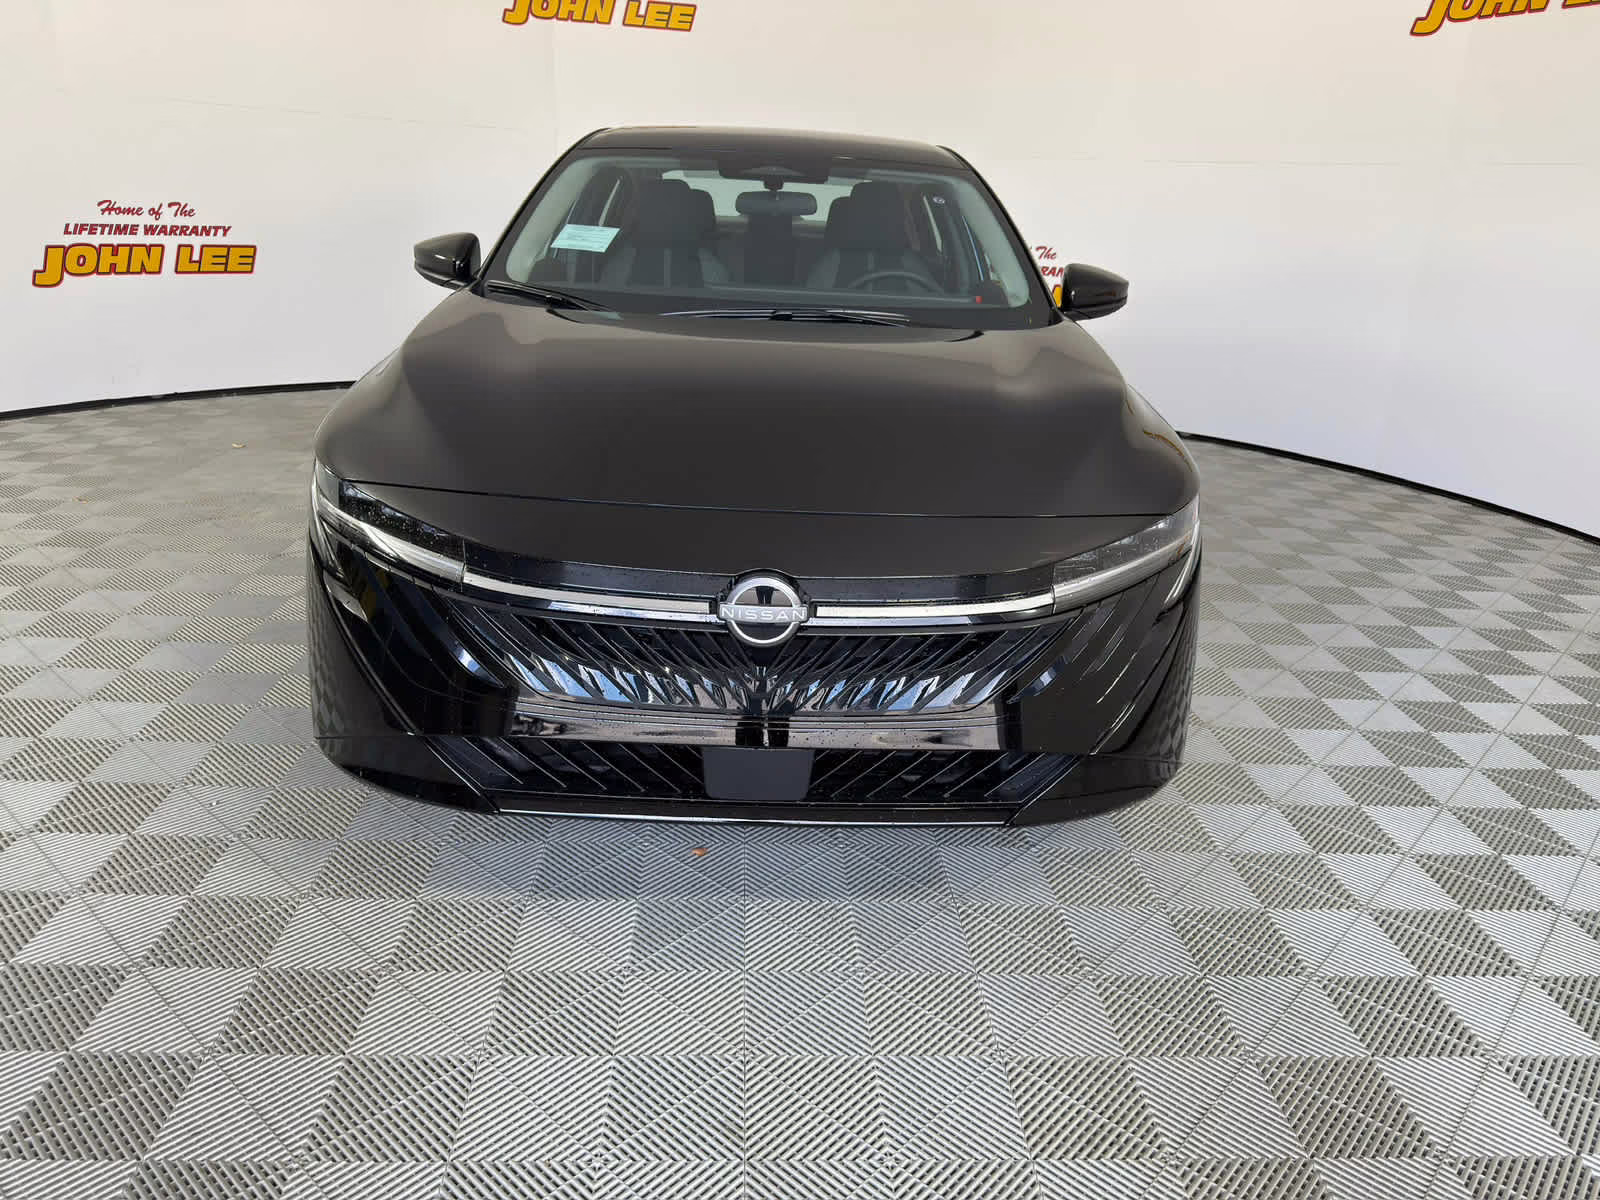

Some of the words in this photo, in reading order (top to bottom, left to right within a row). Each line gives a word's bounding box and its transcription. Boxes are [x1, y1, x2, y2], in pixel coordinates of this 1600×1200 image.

[502, 0, 616, 25] JOHN
[622, 0, 697, 32] LEE
[97, 199, 144, 217] Home
[148, 202, 163, 220] of
[167, 201, 196, 218] The
[63, 222, 139, 236] LIFETIME
[143, 224, 232, 238] WARRANTY
[1035, 246, 1057, 260] The
[32, 242, 165, 288] JOHN
[174, 243, 257, 275] LEE
[721, 607, 805, 621] NISSAN
